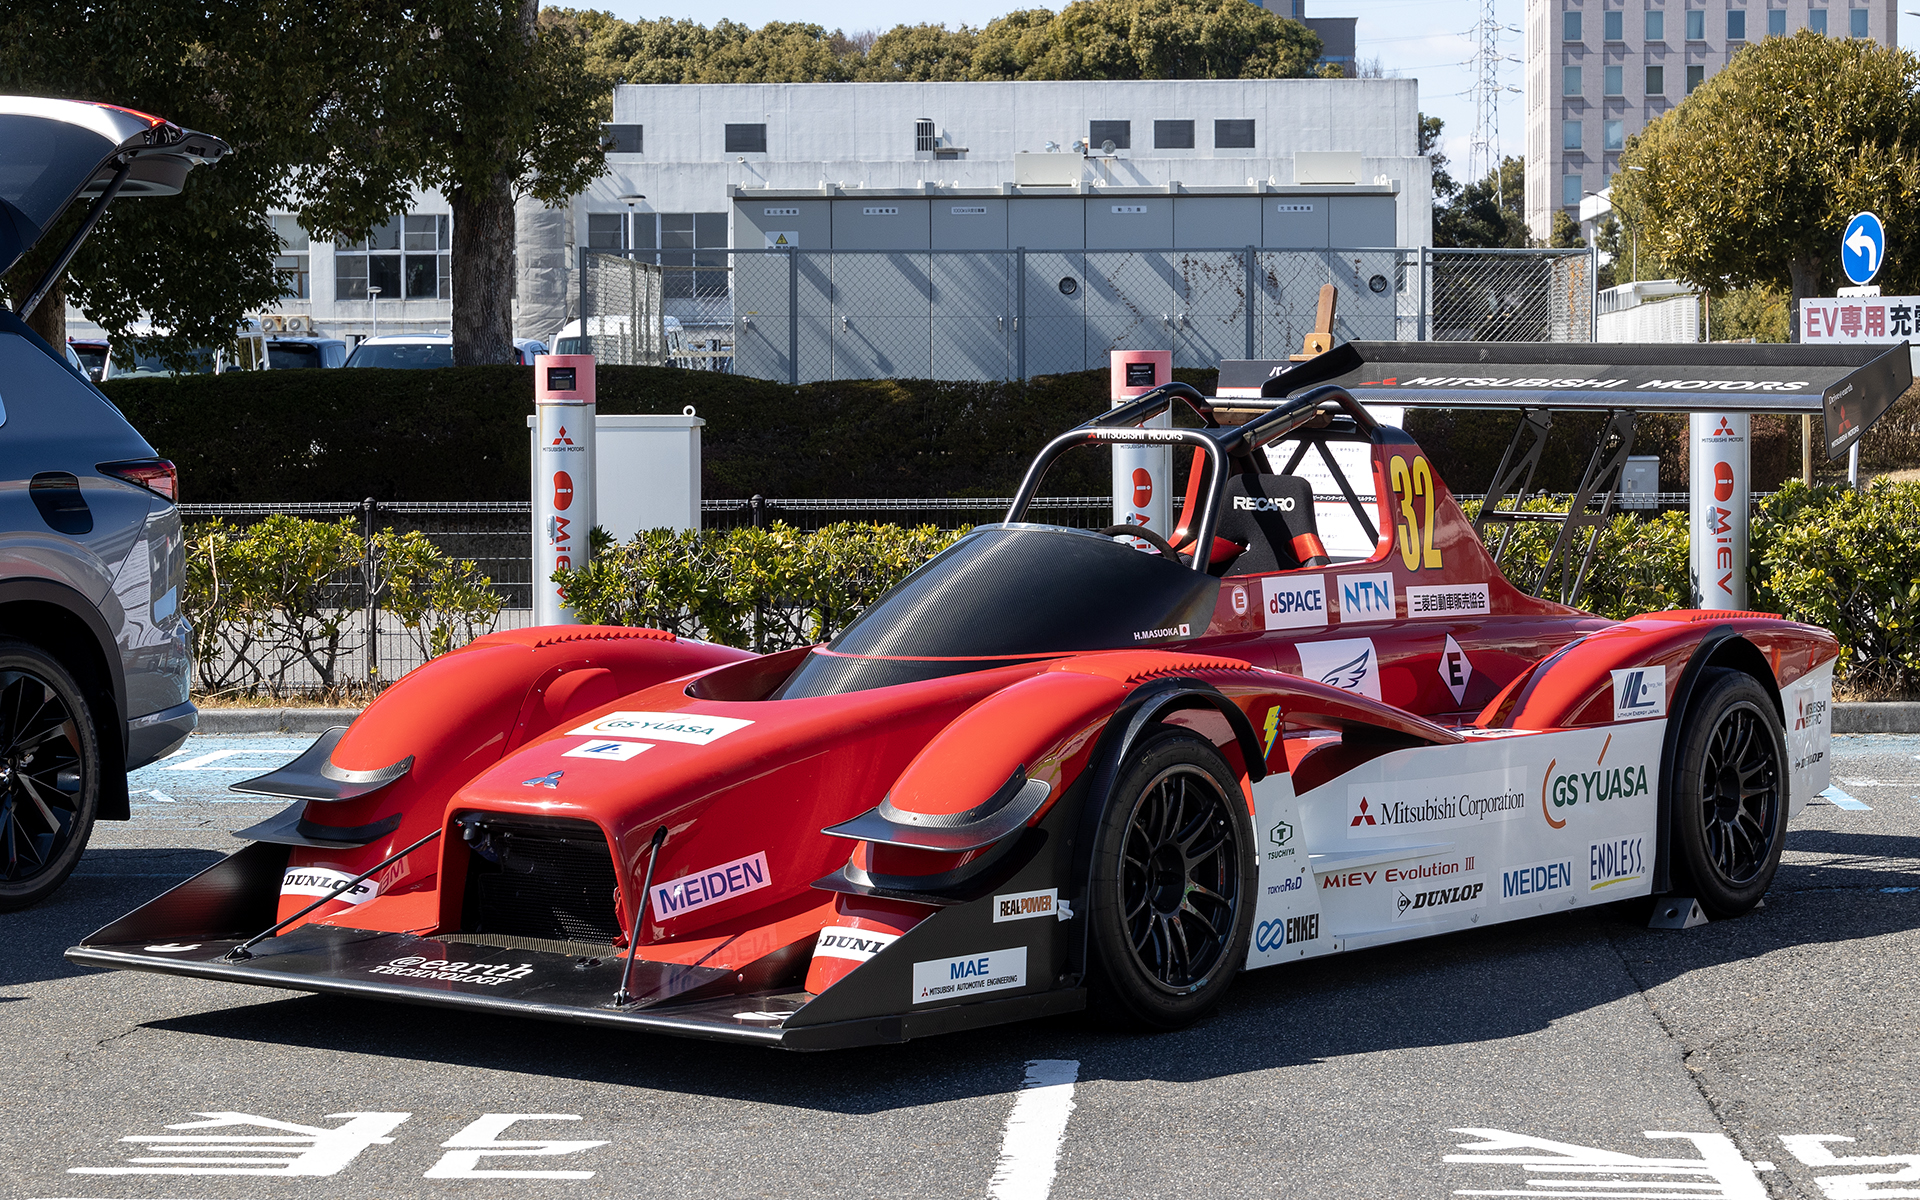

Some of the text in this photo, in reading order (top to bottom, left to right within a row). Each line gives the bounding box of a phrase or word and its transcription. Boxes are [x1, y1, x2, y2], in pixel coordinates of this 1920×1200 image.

[1806, 304, 1920, 337] EV専用充
[1401, 377, 1809, 390] MITSUBISHI MOTORS
[1097, 431, 1183, 441] MITSUBISHI MOTORS
[1847, 425, 1860, 439] MOTORS
[1233, 496, 1296, 512] RECARO
[1389, 454, 1444, 572] 32
[1716, 507, 1733, 596] MiEV
[1234, 592, 1245, 609] E
[1269, 589, 1322, 614] dSPACE
[1343, 580, 1390, 613] NTN
[1413, 591, 1486, 612] 三菱自動車販売協会
[1133, 627, 1179, 641] H.MASUOKA
[1446, 652, 1464, 687] E
[608, 720, 714, 735] GS YUASA
[1553, 764, 1650, 808] GS YUASA
[1380, 788, 1525, 826] Mitsubishi Corporation
[1267, 847, 1296, 861] TSUCHIYA
[658, 858, 765, 915] MEIDEN
[1322, 870, 1378, 890] MiEV
[1385, 862, 1459, 883] Evolution
[1503, 861, 1571, 898] MEIDEN
[1412, 883, 1484, 910] DUNLOP
[1286, 913, 1319, 945] ENKEI
[369, 965, 513, 985] TECHNOLOGY
[388, 955, 534, 979] @earth
[950, 958, 990, 980] MAE
[929, 974, 1018, 996] MITSUBISHI AUTOMOTIVE ENGINEERING
